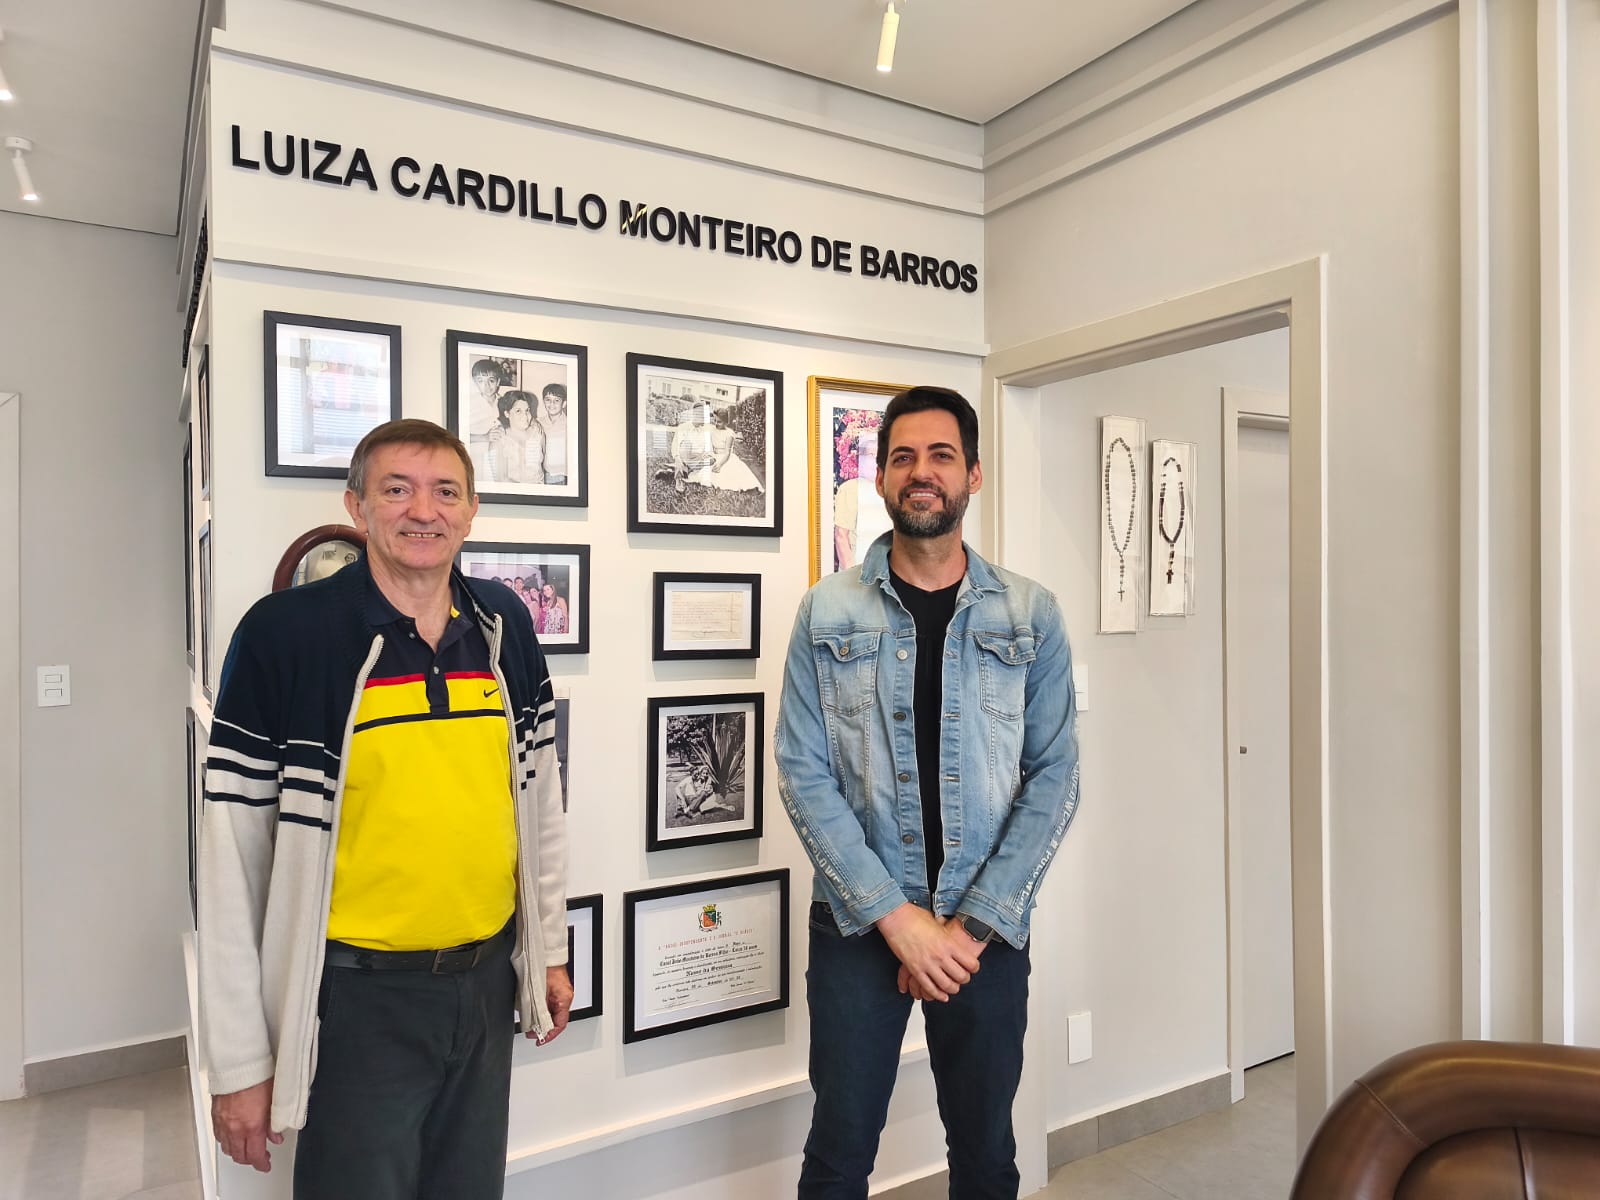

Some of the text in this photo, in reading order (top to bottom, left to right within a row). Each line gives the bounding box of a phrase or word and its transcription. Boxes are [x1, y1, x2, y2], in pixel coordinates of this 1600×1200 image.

[231, 124, 978, 293] LUIZA CARDILLO MONTEIRO DE BARROS
